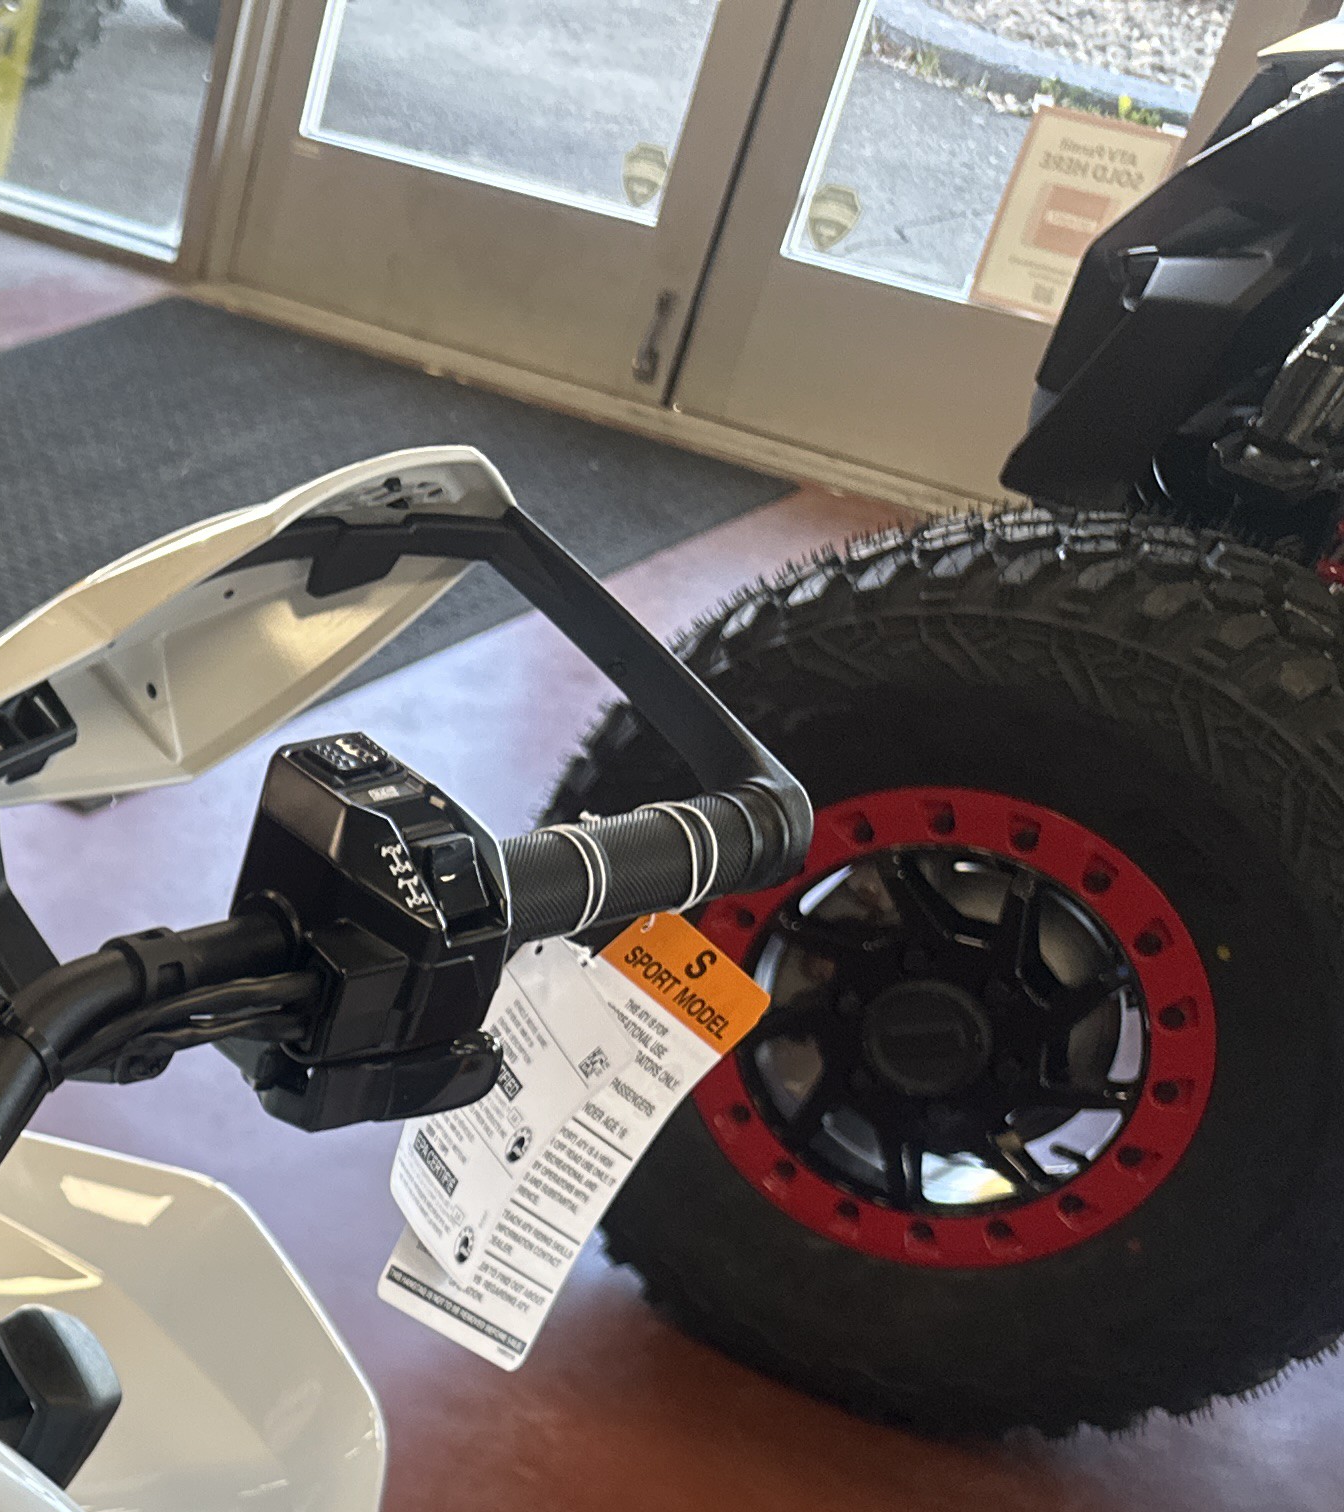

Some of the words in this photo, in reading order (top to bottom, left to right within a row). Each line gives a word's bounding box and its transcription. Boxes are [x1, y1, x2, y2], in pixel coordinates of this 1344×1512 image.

[681, 943, 719, 984] S
[622, 942, 682, 998] SPORT
[672, 983, 733, 1040] MODEL
[648, 1039, 669, 1060] USE
[580, 1099, 606, 1123] NDER
[600, 1113, 621, 1134] AGE
[608, 1075, 657, 1118] PASSENGERS
